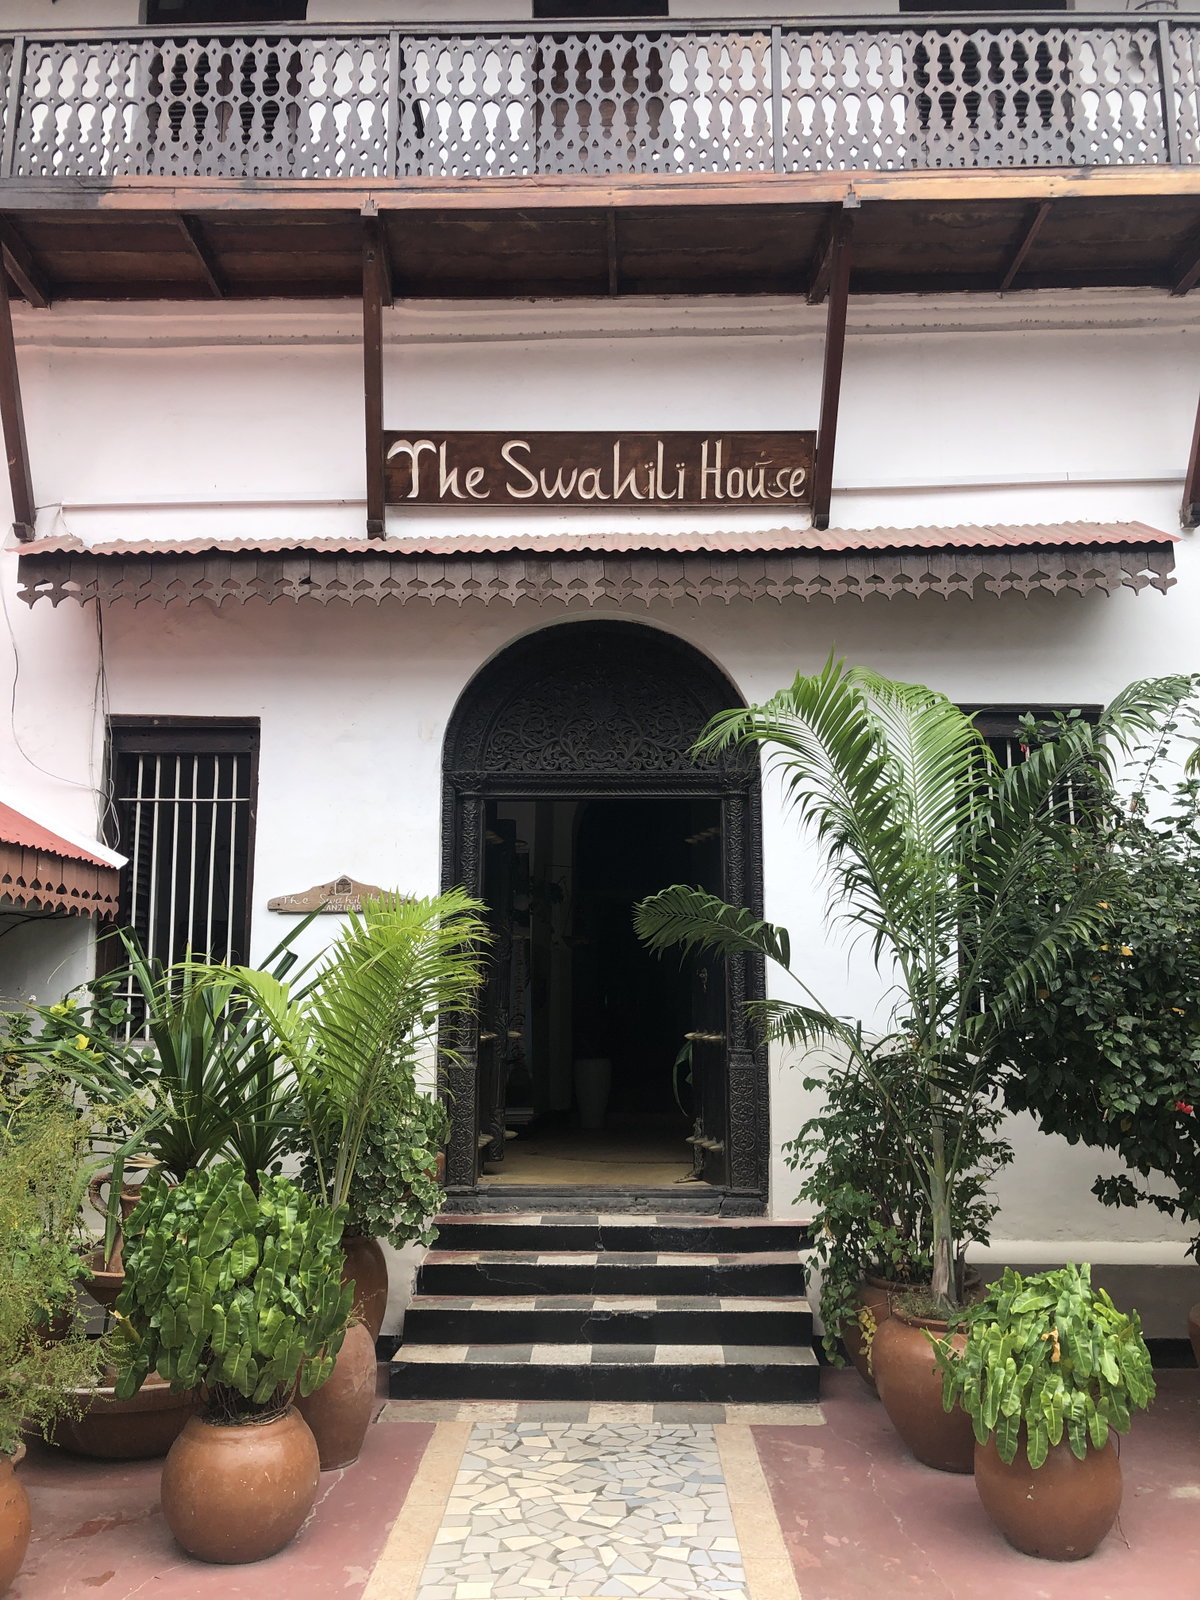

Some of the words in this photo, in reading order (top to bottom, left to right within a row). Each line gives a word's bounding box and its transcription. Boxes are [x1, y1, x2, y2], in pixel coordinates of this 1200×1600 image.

[387, 439, 491, 499] The
[700, 439, 807, 499] House
[280, 896, 310, 906] The
[319, 893, 364, 906] Swahil
